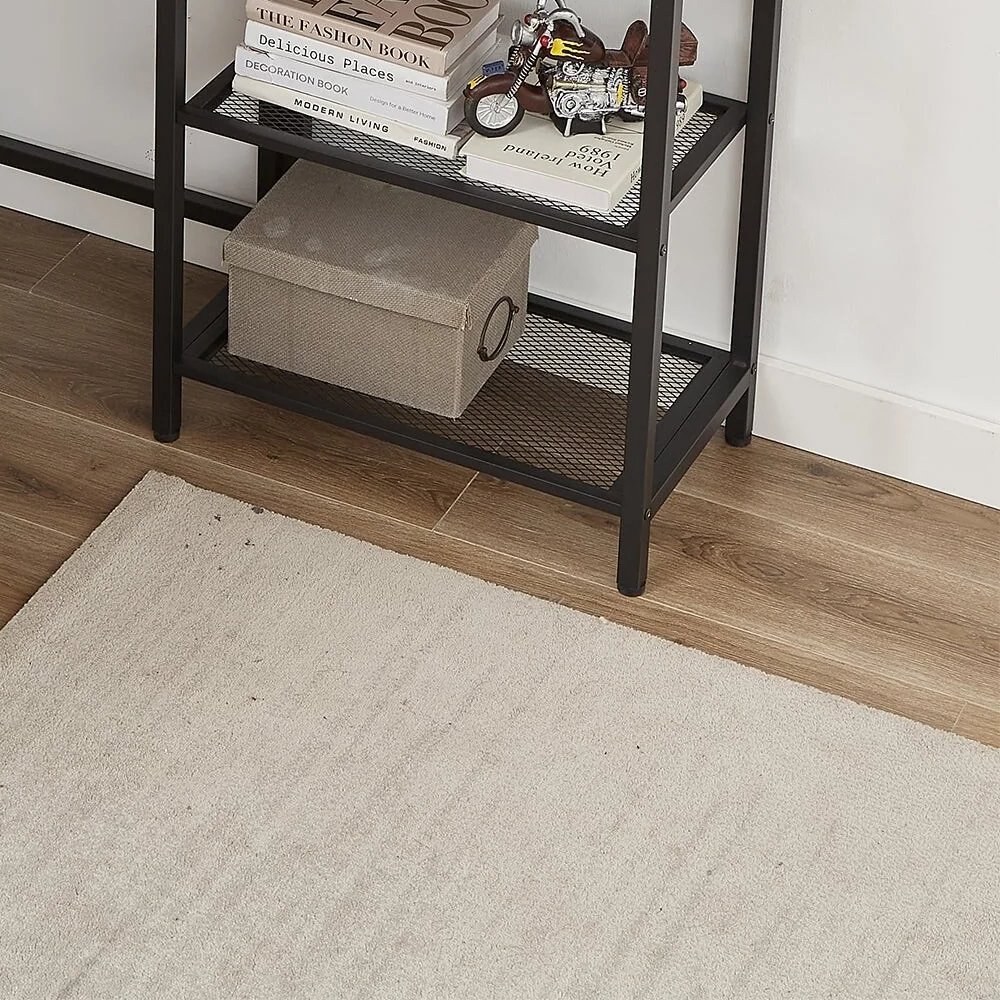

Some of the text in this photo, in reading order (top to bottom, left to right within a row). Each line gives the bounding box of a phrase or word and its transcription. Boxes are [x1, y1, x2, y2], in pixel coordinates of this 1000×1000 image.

[256, 7, 294, 29] THE
[379, 42, 431, 70] BOOK
[259, 34, 335, 66] Delicious
[343, 57, 395, 83] Places
[245, 59, 350, 97] DECORATION BOOK
[294, 98, 447, 152] MODERN LIVING FASHION
[503, 144, 609, 177] How Ireland
[564, 151, 613, 170] Voted
[579, 145, 622, 161] 1989
